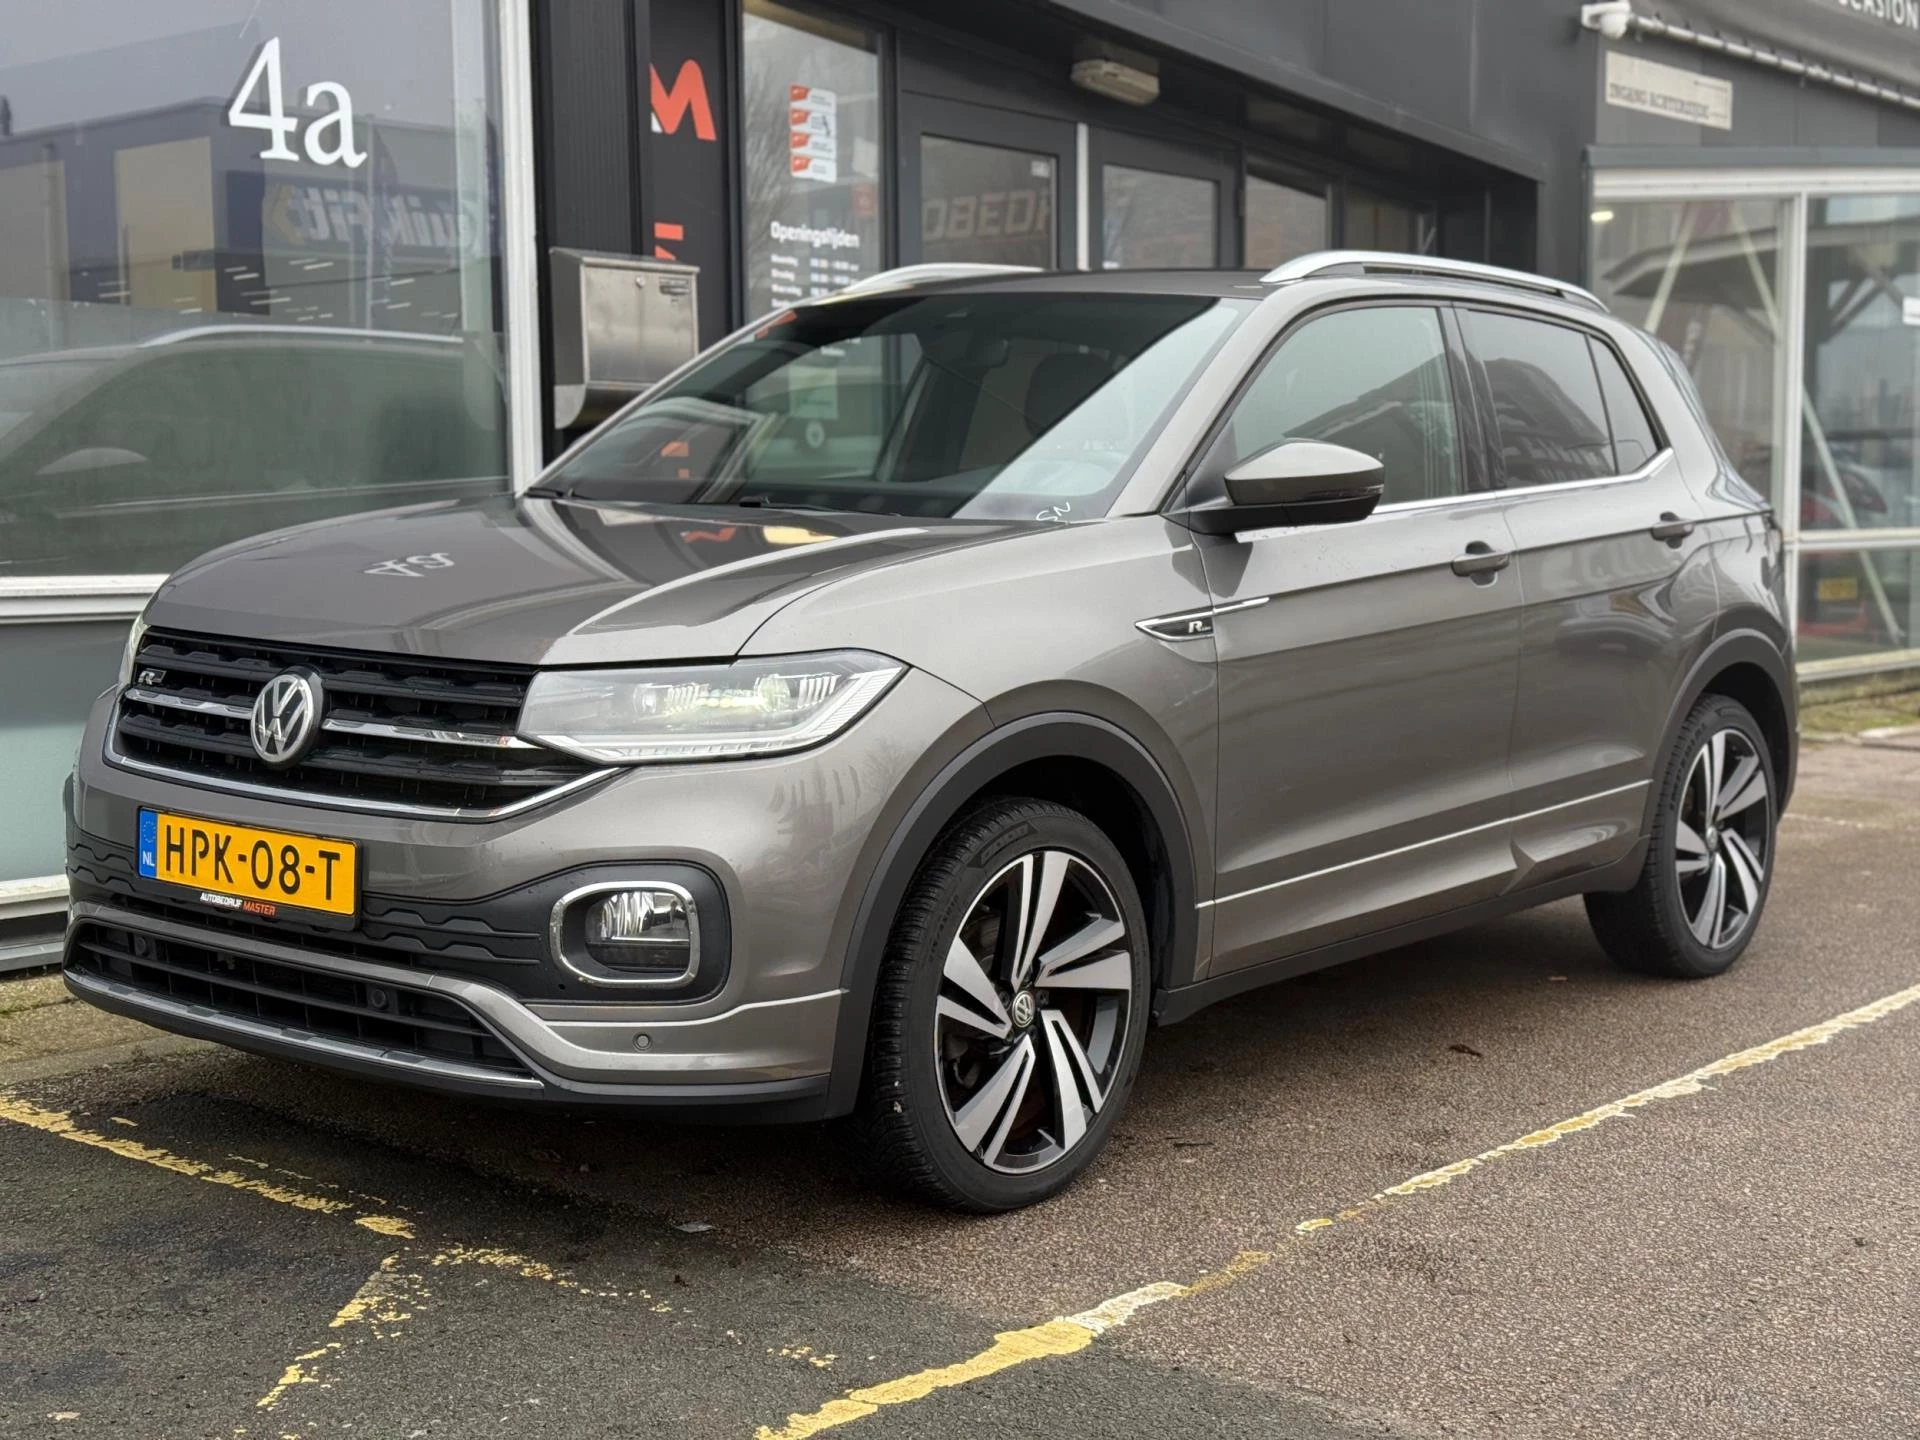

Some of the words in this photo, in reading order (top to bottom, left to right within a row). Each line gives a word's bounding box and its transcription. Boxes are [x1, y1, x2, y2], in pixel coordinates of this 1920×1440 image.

[228, 36, 368, 168] 4a
[771, 220, 859, 250] Openingstijden
[142, 851, 155, 867] NL
[165, 824, 341, 901] HPK-08-T
[200, 892, 243, 909] AUTOBEDRIJF
[243, 900, 277, 917] MASTER
